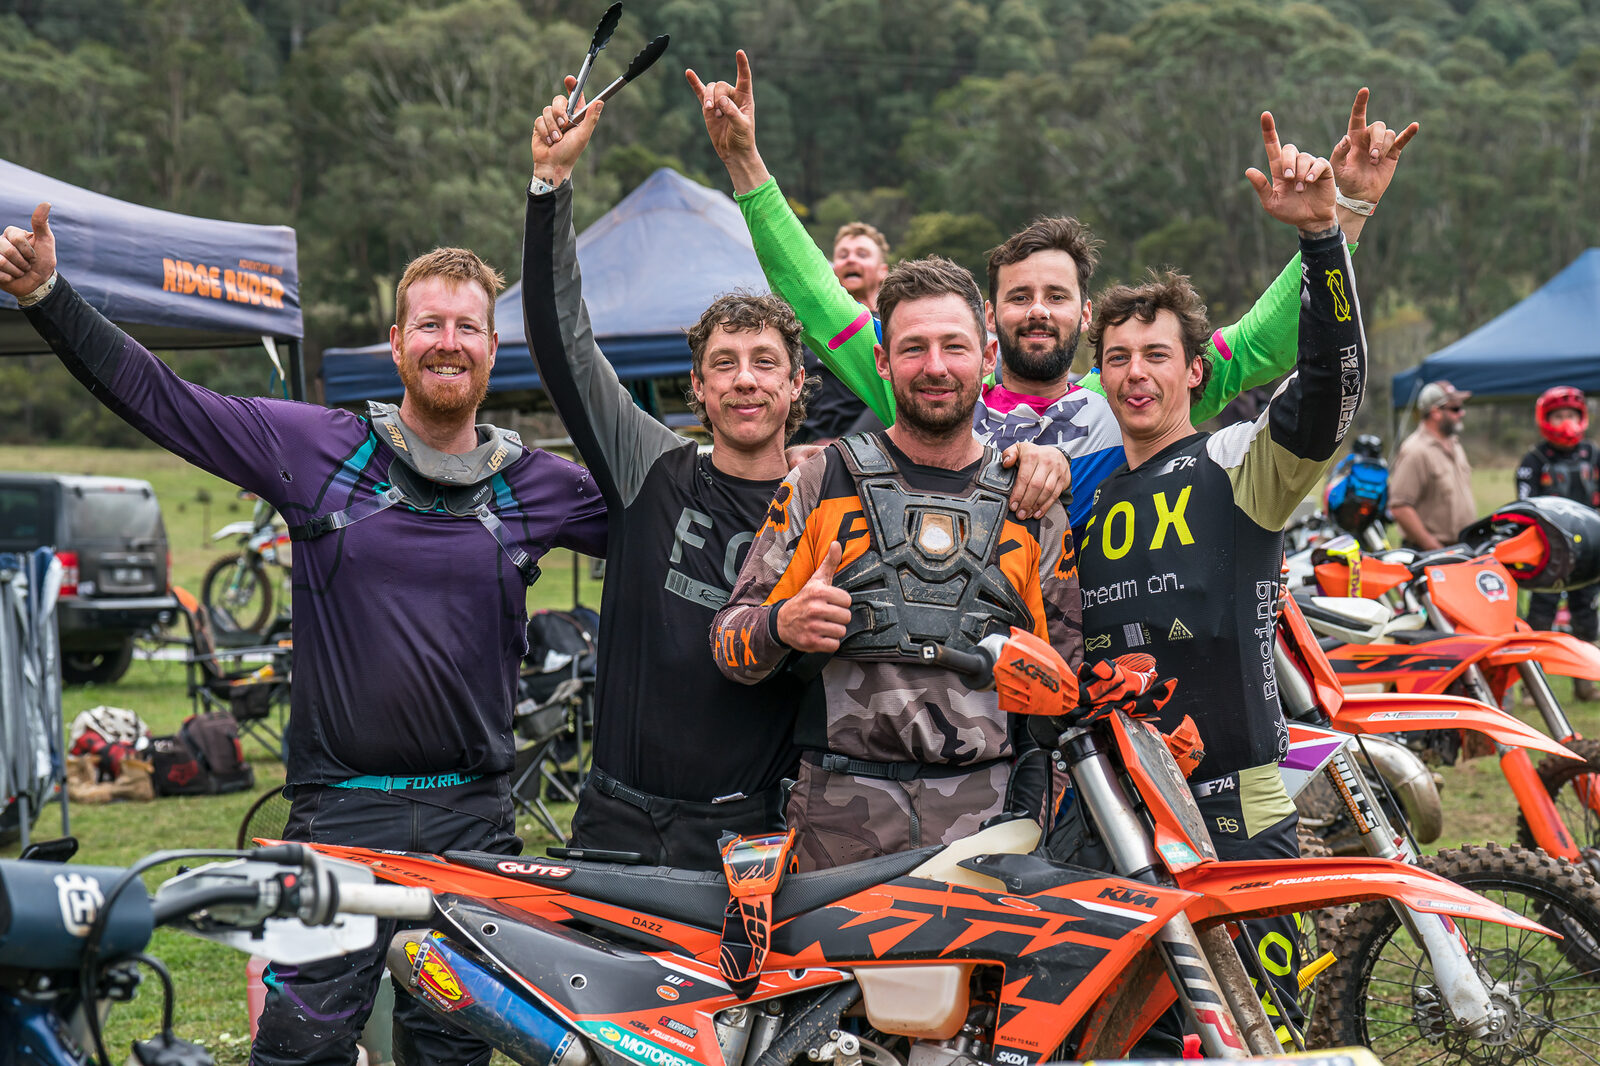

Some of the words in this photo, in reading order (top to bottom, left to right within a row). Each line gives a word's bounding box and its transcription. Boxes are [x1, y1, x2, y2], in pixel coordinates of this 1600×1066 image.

[162, 257, 222, 299] RIDGE
[223, 268, 285, 309] RYDER
[1333, 343, 1362, 443] RACEWEAR
[383, 421, 409, 452] LEATT
[487, 444, 510, 472] LEATT
[1080, 579, 1138, 610] Dream
[1147, 572, 1185, 594] on.
[715, 625, 758, 667] FOX
[1254, 580, 1278, 701] Racing
[1206, 776, 1236, 794] F74
[1216, 816, 1240, 833] RS
[496, 861, 572, 878] GUTS
[1096, 886, 1160, 909] KTM
[631, 915, 664, 934] DAZZ
[663, 974, 695, 987] WP
[650, 1028, 696, 1053] POWERPARTS
